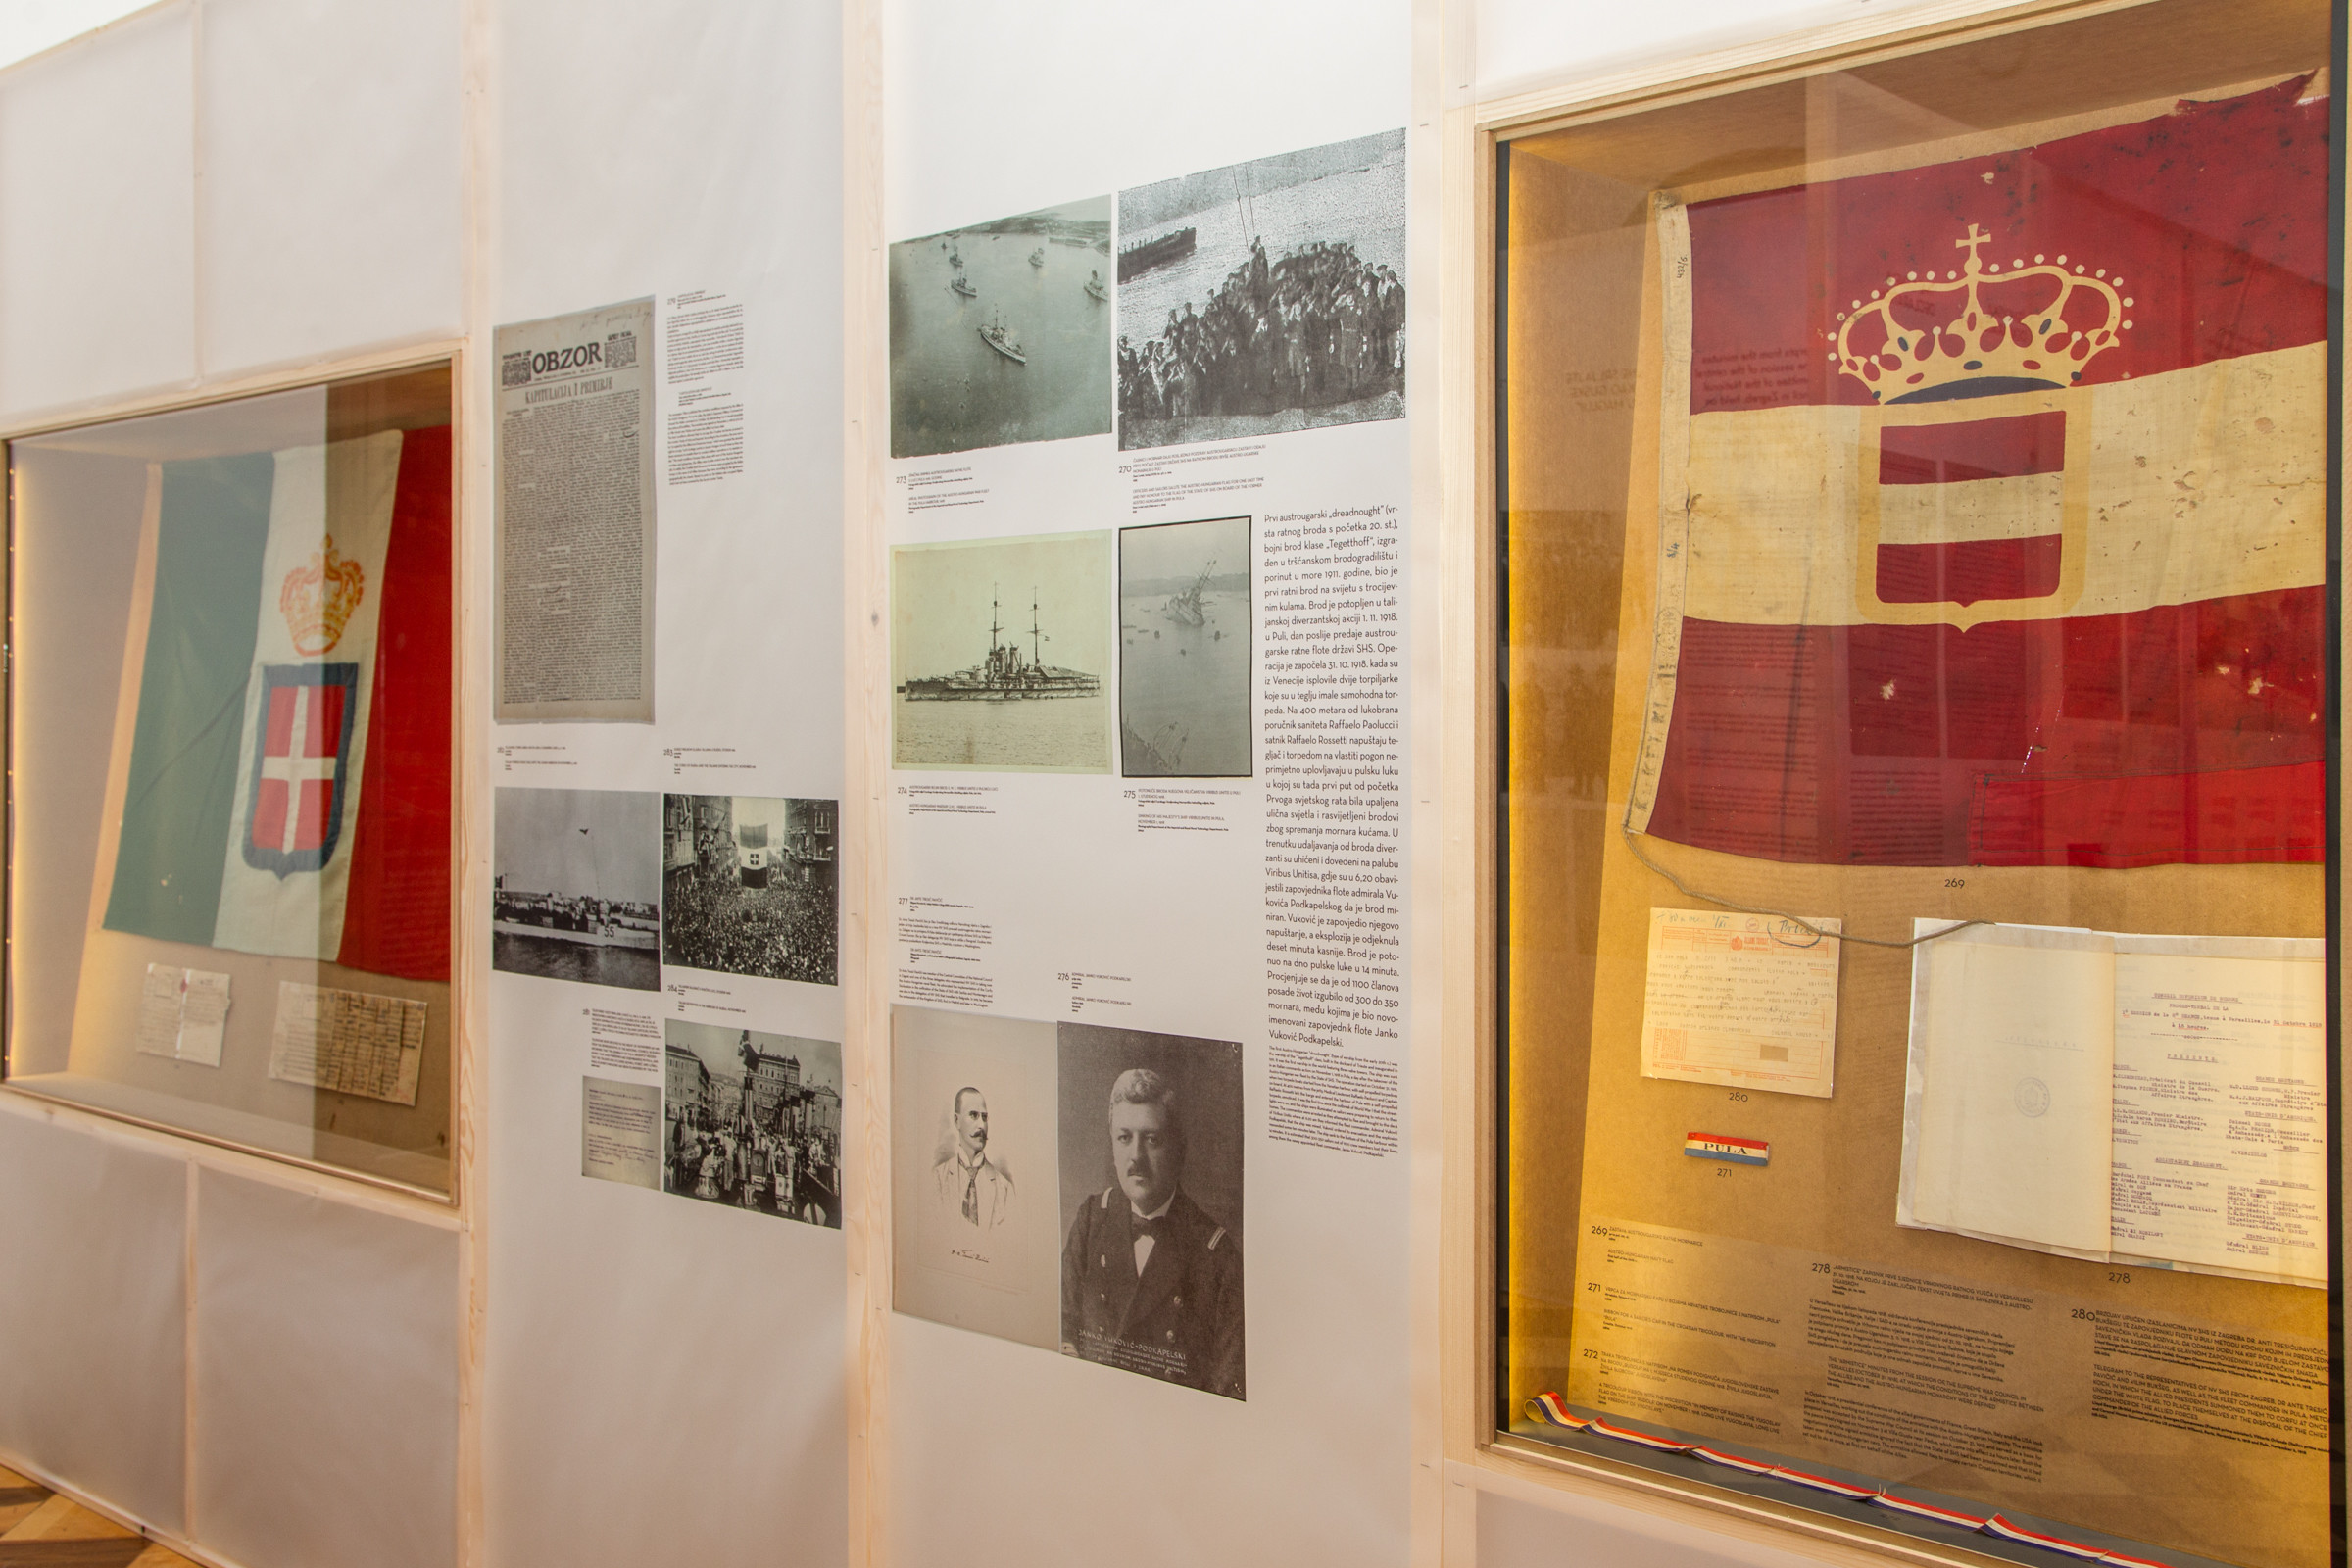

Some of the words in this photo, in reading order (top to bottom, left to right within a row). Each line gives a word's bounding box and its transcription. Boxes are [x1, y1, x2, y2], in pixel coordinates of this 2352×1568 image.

[532, 342, 602, 374] OBZOR
[1119, 466, 1132, 474] 270
[1280, 510, 1327, 522] austrougarski
[1386, 505, 1398, 514] (vr-
[1288, 555, 1331, 565] tršćanskom
[1334, 551, 1393, 564] brodogradilištu
[1265, 616, 1289, 628] janskoj
[1292, 614, 1340, 625] diverzantskoj
[1343, 613, 1360, 625] akciji
[1380, 612, 1398, 622] 1918.
[1265, 646, 1289, 658] garske
[1312, 645, 1330, 654] flote
[1332, 645, 1354, 654] državi
[1357, 644, 1375, 653] SHS.
[1378, 643, 1398, 655] Ope-
[1273, 676, 1304, 687] Venecije
[1306, 674, 1337, 686] isplovile
[1339, 674, 1357, 686] dvije
[1360, 673, 1398, 685] torpiljarke
[1265, 706, 1285, 716] peda.
[1288, 706, 1298, 714] Na
[1348, 705, 1358, 713] od
[1361, 704, 1398, 713] lukobrana
[1265, 720, 1296, 731] poručnik
[1329, 719, 1360, 729] Raffaelo
[1363, 719, 1395, 729] Paolucci
[1266, 765, 1300, 776] primjetno
[1303, 764, 1346, 777] uplovljavaju
[1355, 765, 1380, 777] pulsku
[1383, 765, 1398, 775] luku
[1124, 790, 1136, 799] 275
[1267, 794, 1292, 806] Prvoga
[1295, 795, 1329, 807] svjetskog
[1349, 796, 1363, 806] bila
[1366, 797, 1398, 808] upaljena
[1266, 808, 1288, 818] ulična
[1291, 809, 1314, 821] svjetla
[1322, 810, 1365, 822] rasvijetljeni
[1369, 811, 1398, 822] brodovi
[1266, 839, 1296, 848] trenutku
[1298, 840, 1338, 853] udaljavanja
[1340, 842, 1349, 851] od
[1351, 841, 1374, 852] broda
[1376, 843, 1398, 853] diver-
[1944, 878, 1965, 889] 269
[1288, 913, 1316, 924] Vuković
[1317, 916, 1324, 927] je
[1326, 918, 1367, 929] zapovjedio
[1369, 920, 1399, 932] njegovo
[1267, 941, 1287, 952] deset
[1290, 945, 1314, 954] minuta
[1317, 945, 1345, 958] kasnije.
[1348, 948, 1367, 958] Brod
[1369, 950, 1376, 961] je
[1379, 952, 1399, 961] poto-
[1269, 1015, 1306, 1027] imenovani
[1308, 1022, 1352, 1033] zapovjednik
[1354, 1024, 1372, 1036] flote
[1375, 1027, 1398, 1039] Janko
[1269, 1029, 1297, 1041] Vuković
[1299, 1033, 1344, 1047] Podkapelski.
[1729, 1092, 1748, 1102] 280
[1704, 1143, 1747, 1154] PULA
[1717, 1168, 1732, 1178] 271
[1592, 1226, 1607, 1236] 269
[1812, 1263, 1830, 1273] 278
[2109, 1272, 2131, 1284] 278
[1588, 1282, 1601, 1292] 271
[2072, 1309, 2095, 1321] 280
[1584, 1348, 1598, 1359] 272
